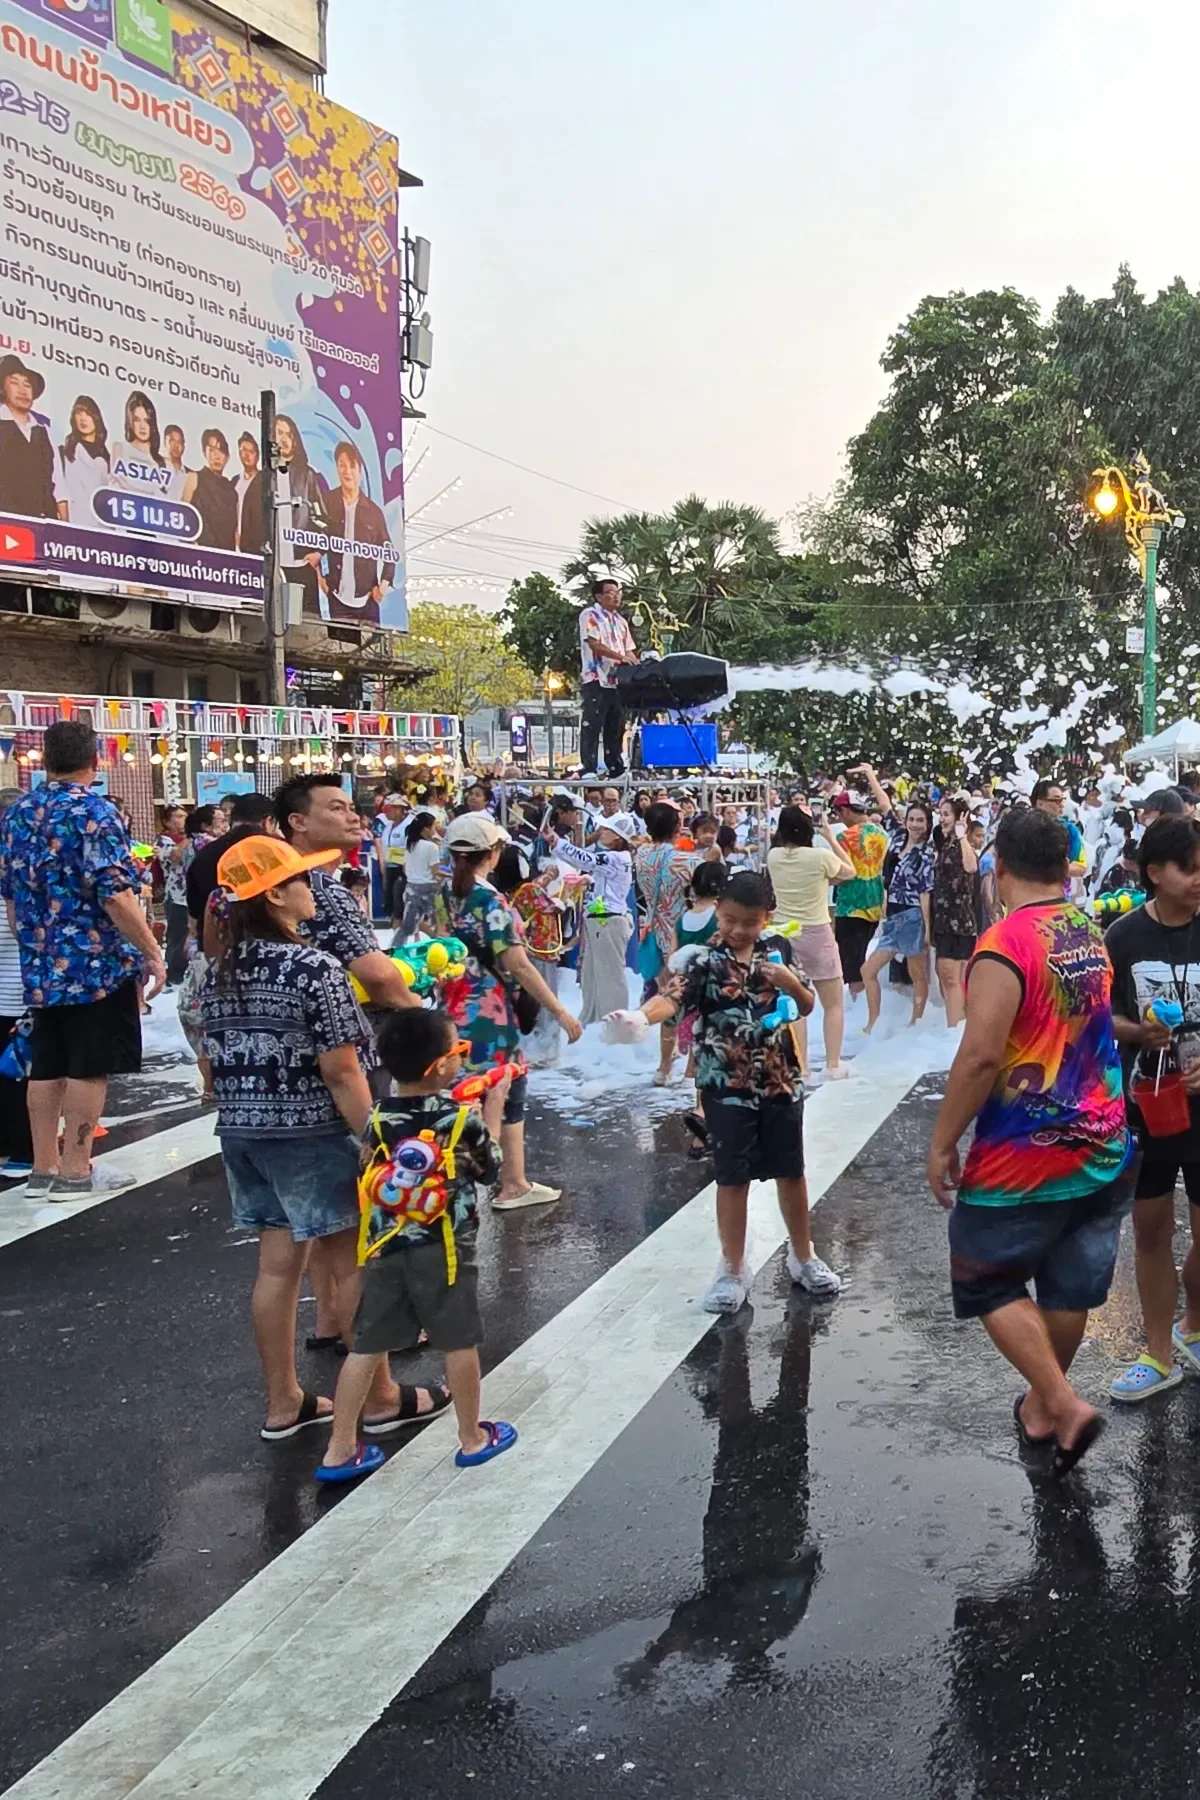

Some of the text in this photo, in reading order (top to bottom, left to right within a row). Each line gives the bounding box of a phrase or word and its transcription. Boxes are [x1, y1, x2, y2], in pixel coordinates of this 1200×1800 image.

[1, 24, 233, 155] ถนนข้าวเหนียว
[0, 79, 246, 221] 2-15 เมษายน 2569
[3, 158, 115, 223] รำวงย้อนยุค
[3, 189, 242, 297] ร่วมตบประทาย (ก่อกองทราย)
[311, 263, 328, 280] 20
[5, 222, 195, 306] กิจกรรมถนนข้าวเหนียว
[199, 298, 225, 317] และ
[228, 300, 295, 341] คลื่นมนุษย์
[42, 343, 110, 377] ประกวด
[115, 365, 164, 392] Cover
[168, 381, 217, 407] Dance
[109, 333, 241, 385] ครอบครัวเดียวกัน
[163, 313, 301, 380] รดน้ำขอพรผู้สูงอายุ
[113, 459, 172, 487] ASIA7
[107, 497, 191, 532] 15 เม.ย.
[283, 528, 328, 550] พลพล
